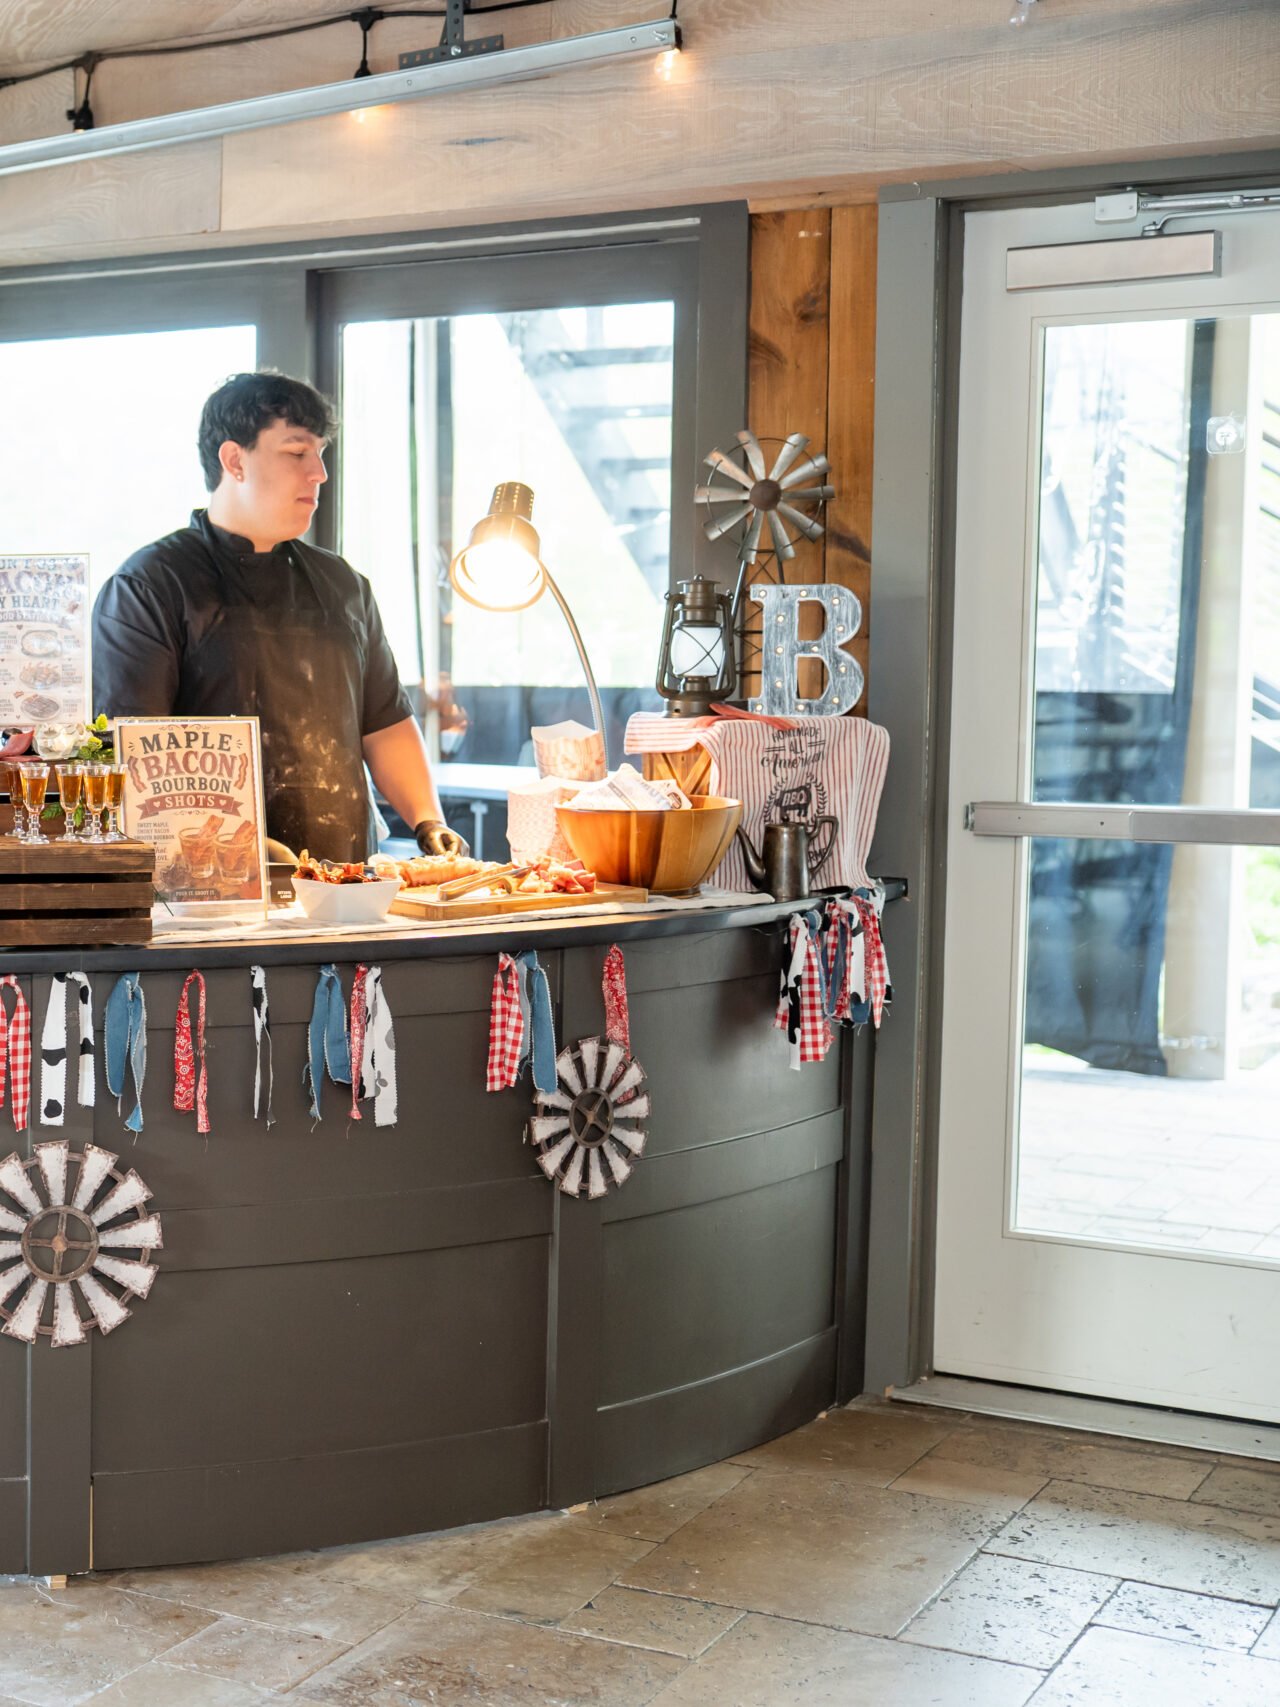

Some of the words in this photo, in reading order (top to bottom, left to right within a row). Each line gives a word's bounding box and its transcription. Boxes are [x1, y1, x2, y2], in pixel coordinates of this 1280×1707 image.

[11, 595, 61, 611] HEART
[748, 583, 865, 717] B
[139, 731, 233, 755] MAPLE
[772, 726, 821, 743] HOMEMADE
[789, 739, 804, 754] ALL
[141, 750, 239, 781] BACON
[150, 777, 232, 796] BOURBON
[164, 795, 216, 809] SHOTS
